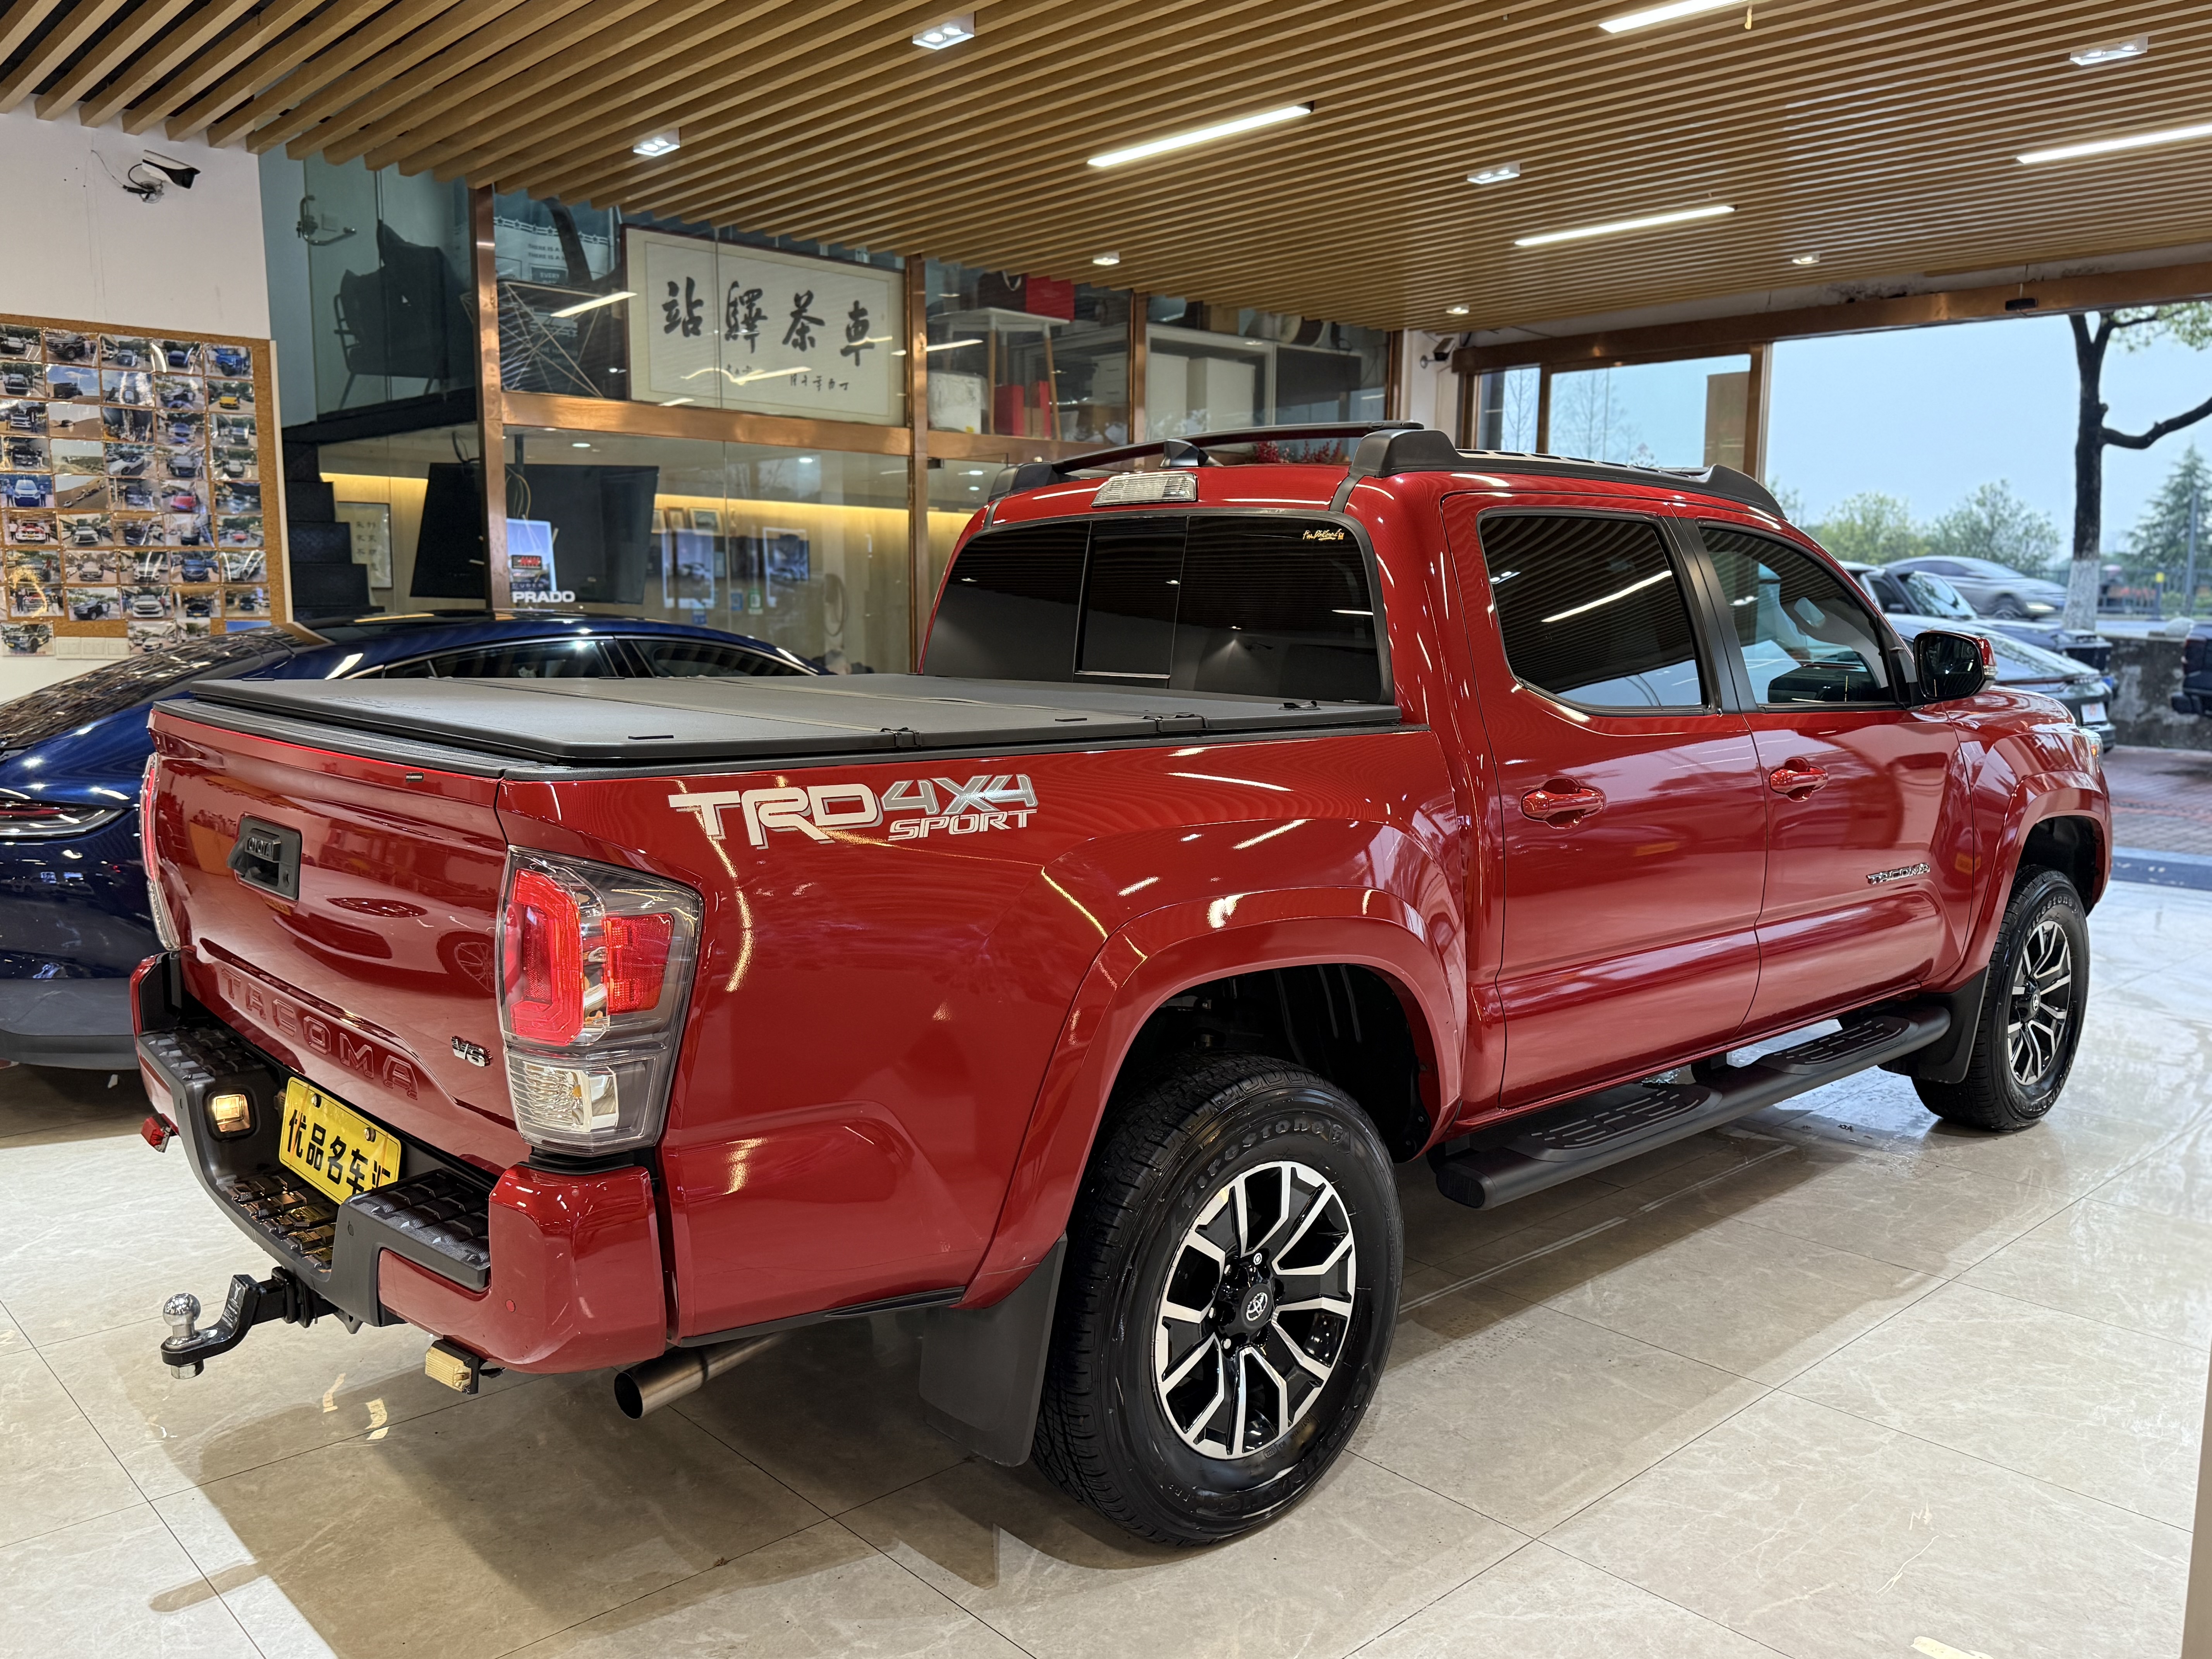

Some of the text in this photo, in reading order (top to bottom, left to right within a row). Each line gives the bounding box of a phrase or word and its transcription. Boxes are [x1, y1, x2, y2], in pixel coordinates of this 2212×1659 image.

[512, 591, 575, 603] PRADO
[668, 783, 884, 850] TRD
[888, 809, 1037, 841] SPORT
[1867, 863, 1930, 884] TACOMA
[220, 966, 419, 1101] TACOMA
[451, 1036, 491, 1067] V6
